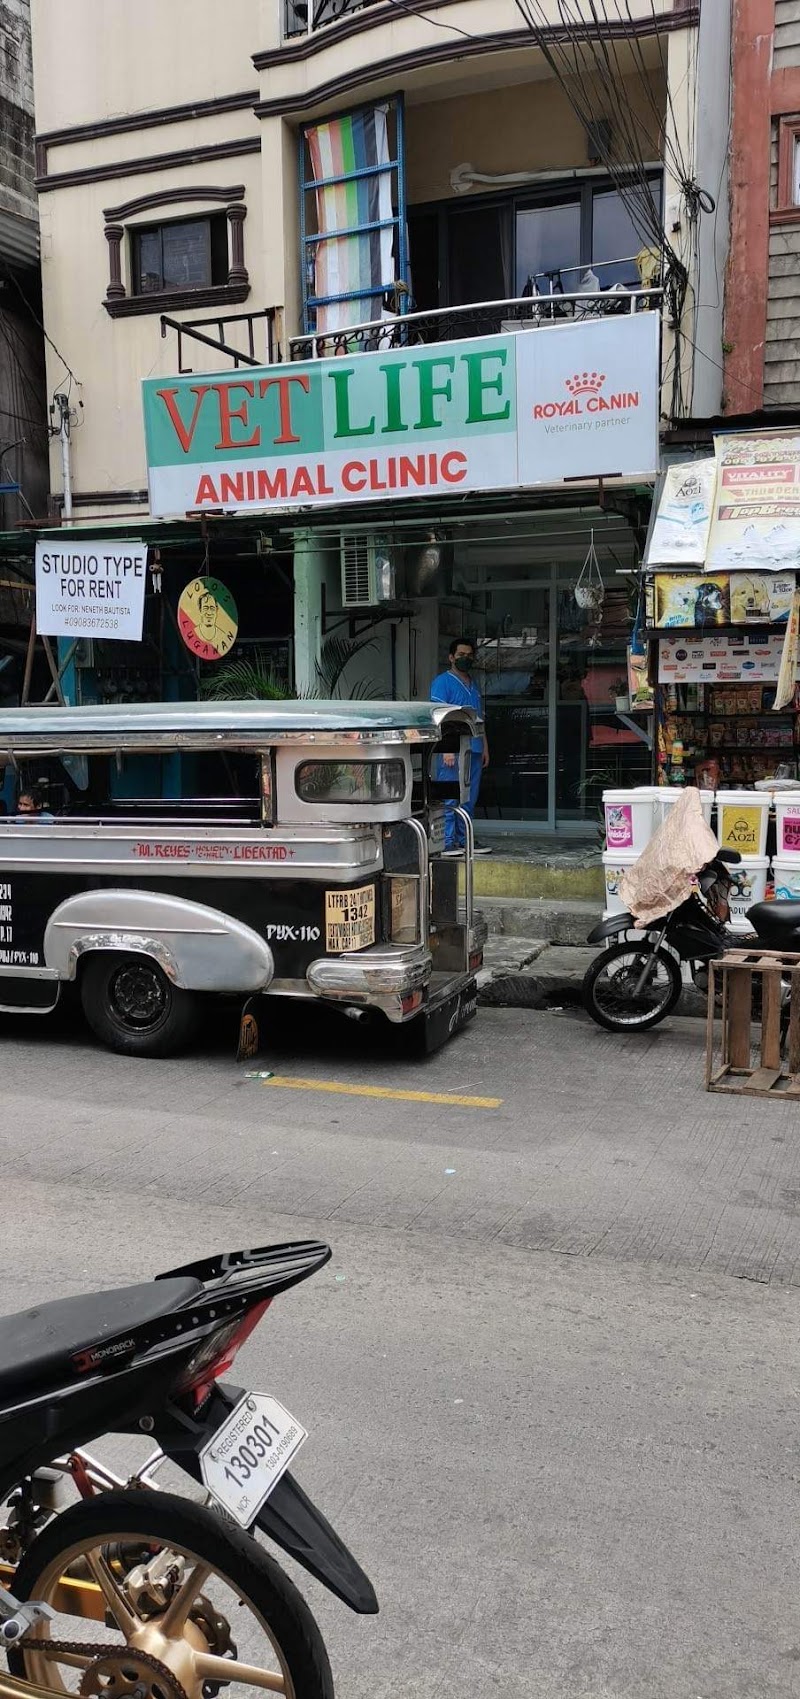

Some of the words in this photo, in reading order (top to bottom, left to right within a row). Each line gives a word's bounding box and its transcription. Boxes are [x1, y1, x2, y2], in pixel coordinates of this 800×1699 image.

[156, 375, 310, 453] VET
[328, 348, 511, 438] LIFE
[533, 399, 583, 419] ROYAL
[586, 391, 639, 412] CANIN
[544, 419, 593, 434] Veterinary
[595, 416, 631, 429] partner
[195, 462, 334, 504] ANIMAL
[341, 450, 468, 492] CLINIC
[727, 469, 793, 479] VITALITY
[675, 482, 702, 497] Aozi
[42, 554, 98, 575] STUDIO
[104, 556, 143, 577] TYPE
[61, 579, 85, 597] FOR
[89, 580, 122, 599] RENT
[187, 580, 230, 602] LOLO'S
[52, 604, 67, 613] LOOK
[81, 606, 103, 615] NENETH
[104, 607, 131, 616] BAUTISTA
[727, 830, 756, 842] Aozi
[234, 846, 287, 860] LIBERTAD
[328, 894, 349, 908] LTFRB
[341, 904, 368, 922] 1342
[217, 1411, 253, 1457] REGISTERED
[223, 1414, 281, 1488] 130301
[237, 1495, 252, 1513] NCR
